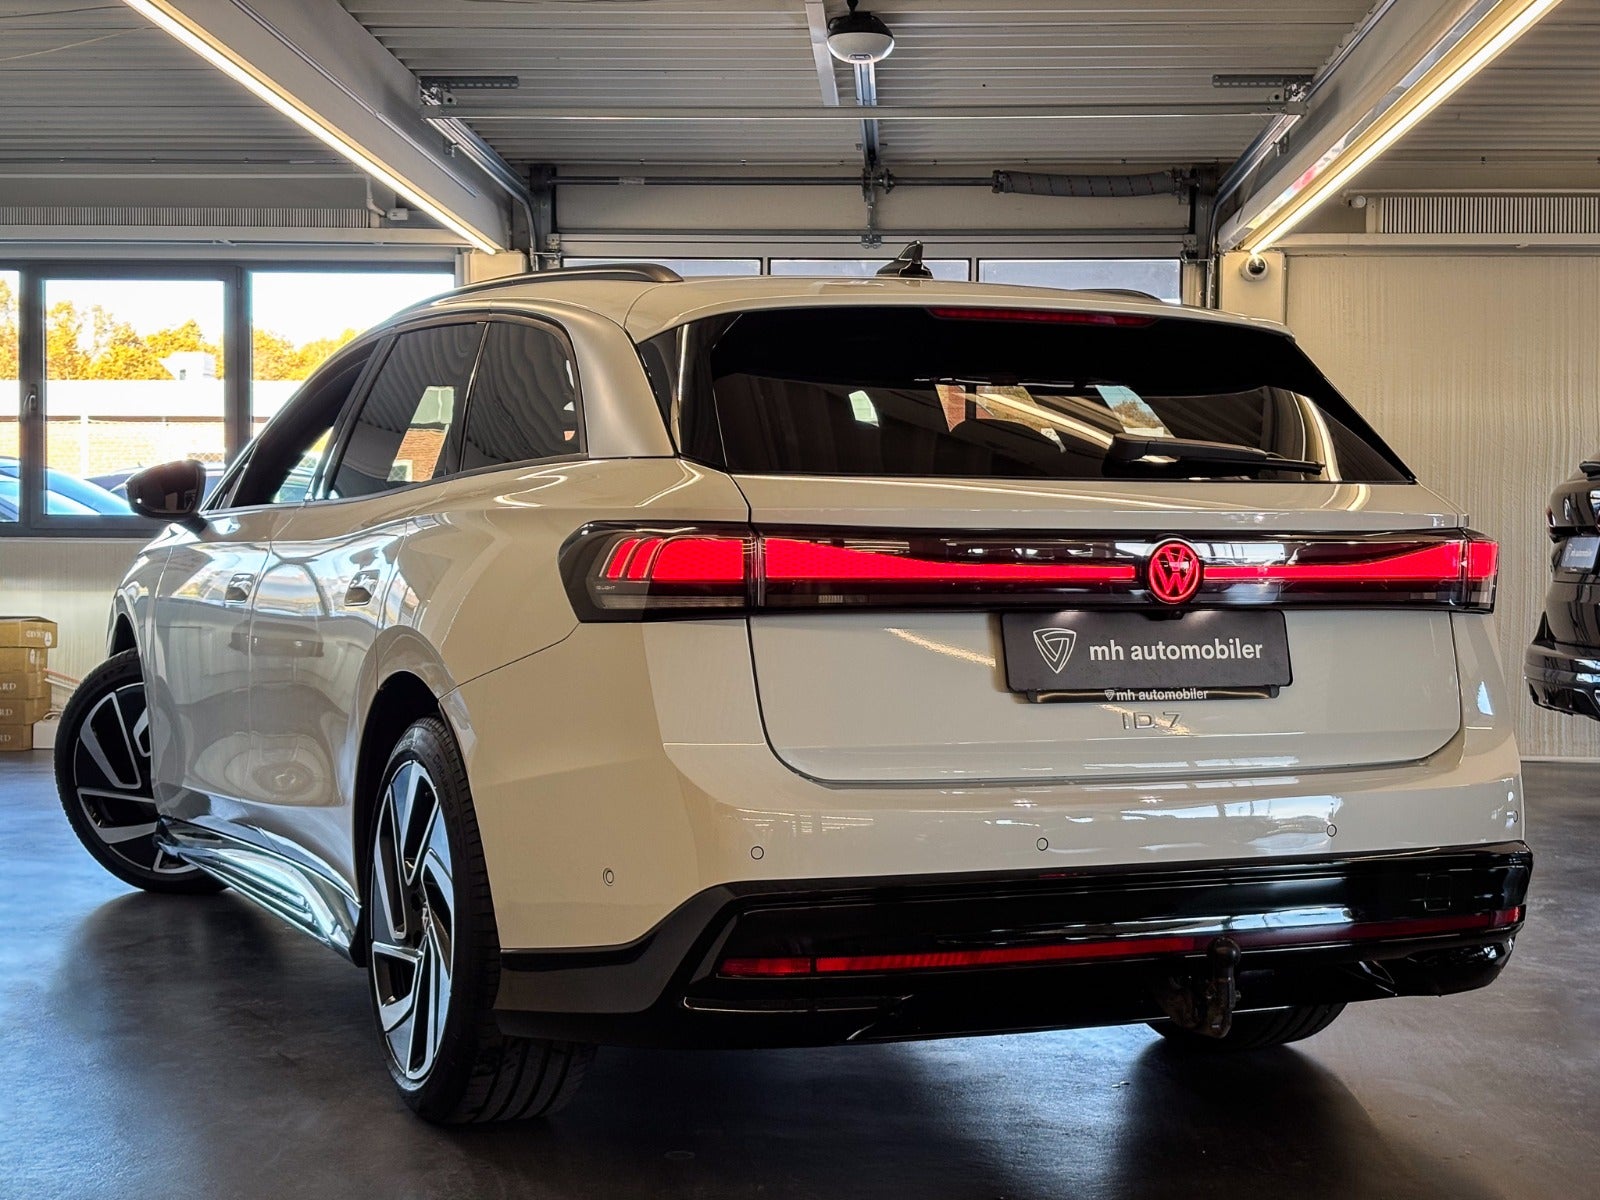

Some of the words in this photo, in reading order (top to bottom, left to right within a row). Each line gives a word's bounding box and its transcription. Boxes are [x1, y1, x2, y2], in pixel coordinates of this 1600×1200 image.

[1089, 640, 1124, 660] mh
[1130, 638, 1263, 660] automobiler
[1116, 689, 1135, 701] mh
[1138, 688, 1209, 700] automobiler
